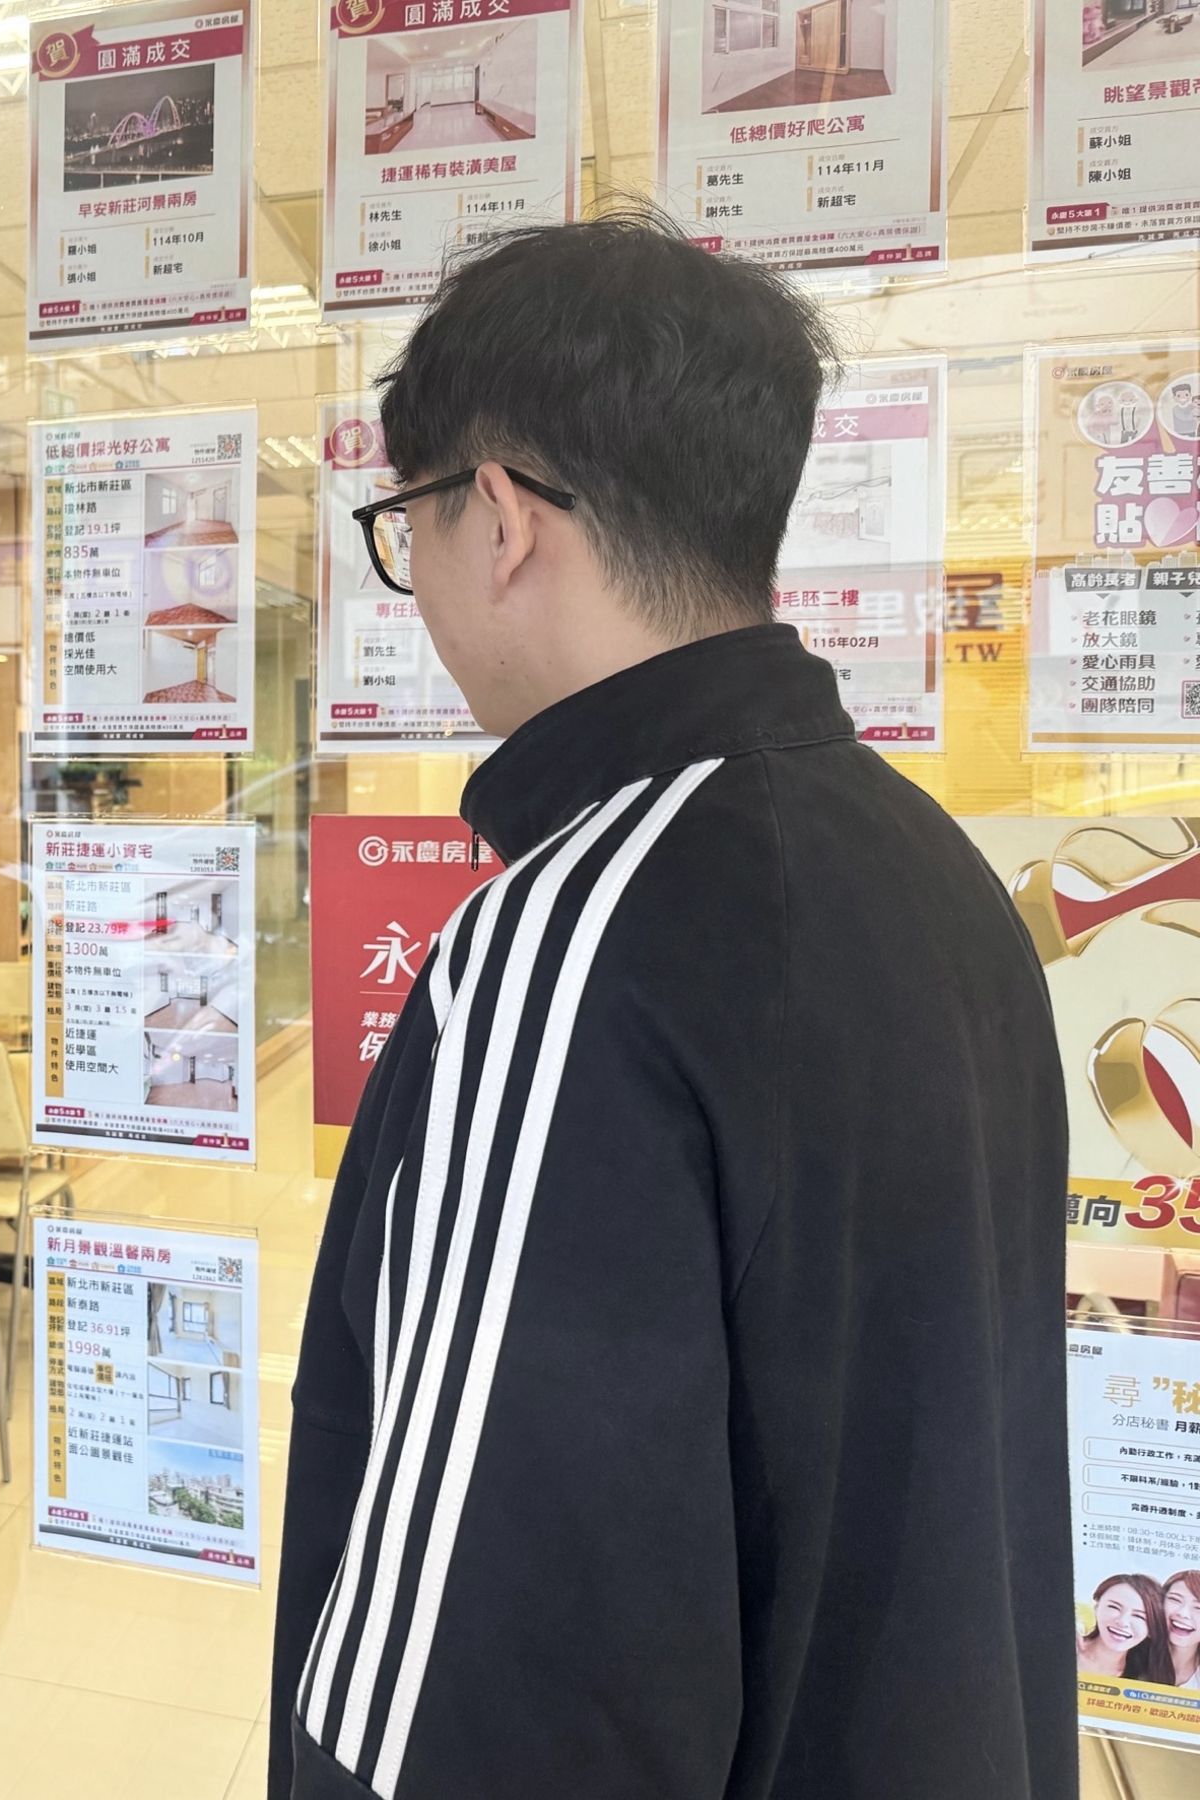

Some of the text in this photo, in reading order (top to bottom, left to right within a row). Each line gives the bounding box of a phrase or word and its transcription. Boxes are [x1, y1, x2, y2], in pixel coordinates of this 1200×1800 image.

[46, 39, 69, 66] 賀
[98, 39, 191, 70] 圓滿成交
[730, 115, 866, 144] 低總價好爬公寓
[1089, 134, 1132, 149] 蘇小姐
[381, 155, 518, 184] 捷運稀有裝潢美屋
[706, 159, 884, 186] 葛先生 114年11月
[1088, 168, 1131, 183] 陳小姐
[78, 191, 197, 219] 早安新莊河景兩房
[369, 199, 525, 222] 林先生 114年11月
[705, 194, 856, 218] 謝先生 新超宅
[153, 232, 204, 247] 114年10月
[368, 239, 402, 253] 徐小姐
[66, 262, 183, 283] 張小姐 新超宅
[46, 437, 171, 459] 低總價採光好公寓
[340, 429, 366, 455] 賀
[1097, 453, 1200, 496] 友善
[65, 480, 132, 493] 新北市新莊區
[64, 545, 99, 559] 835萬
[64, 567, 121, 580] 本物件無車位
[1070, 572, 1137, 587] 高齡長者
[1083, 610, 1157, 626] 老花眼鏡
[64, 631, 96, 643] 總價低
[812, 636, 879, 649] 115年02月
[1082, 632, 1138, 648] 放大鏡
[64, 648, 96, 660] 採光佳
[363, 645, 396, 657] 劉先生
[1082, 654, 1156, 669] 愛心雨具
[64, 664, 117, 676] 空間使用大
[363, 675, 396, 687] 劉小姐
[1081, 676, 1155, 691] 交通協助
[1081, 698, 1154, 713] 團隊陪同
[46, 842, 153, 859] 新莊捷運小資宅
[391, 840, 494, 864] 永慶房屋
[65, 879, 131, 894] 新北市新莊區
[65, 900, 97, 913] 新莊路
[64, 941, 108, 957] 1300萬
[65, 964, 122, 978] 本物件無車位
[361, 1012, 400, 1029] 業務
[65, 1027, 97, 1040] 近捷運
[65, 1043, 97, 1056] 近學區
[65, 1059, 119, 1074] 使用空間大
[47, 1237, 172, 1264] 新月景觀溫馨兩房
[67, 1276, 134, 1295] 新北市新莊區
[67, 1297, 100, 1312] 新泰路
[67, 1340, 111, 1359] 1998萬
[1102, 1375, 1141, 1407] 尋
[1112, 1414, 1169, 1431] 分店秘書
[68, 1427, 134, 1447] 近新莊捷運站
[68, 1443, 134, 1464] 面公園景觀佳
